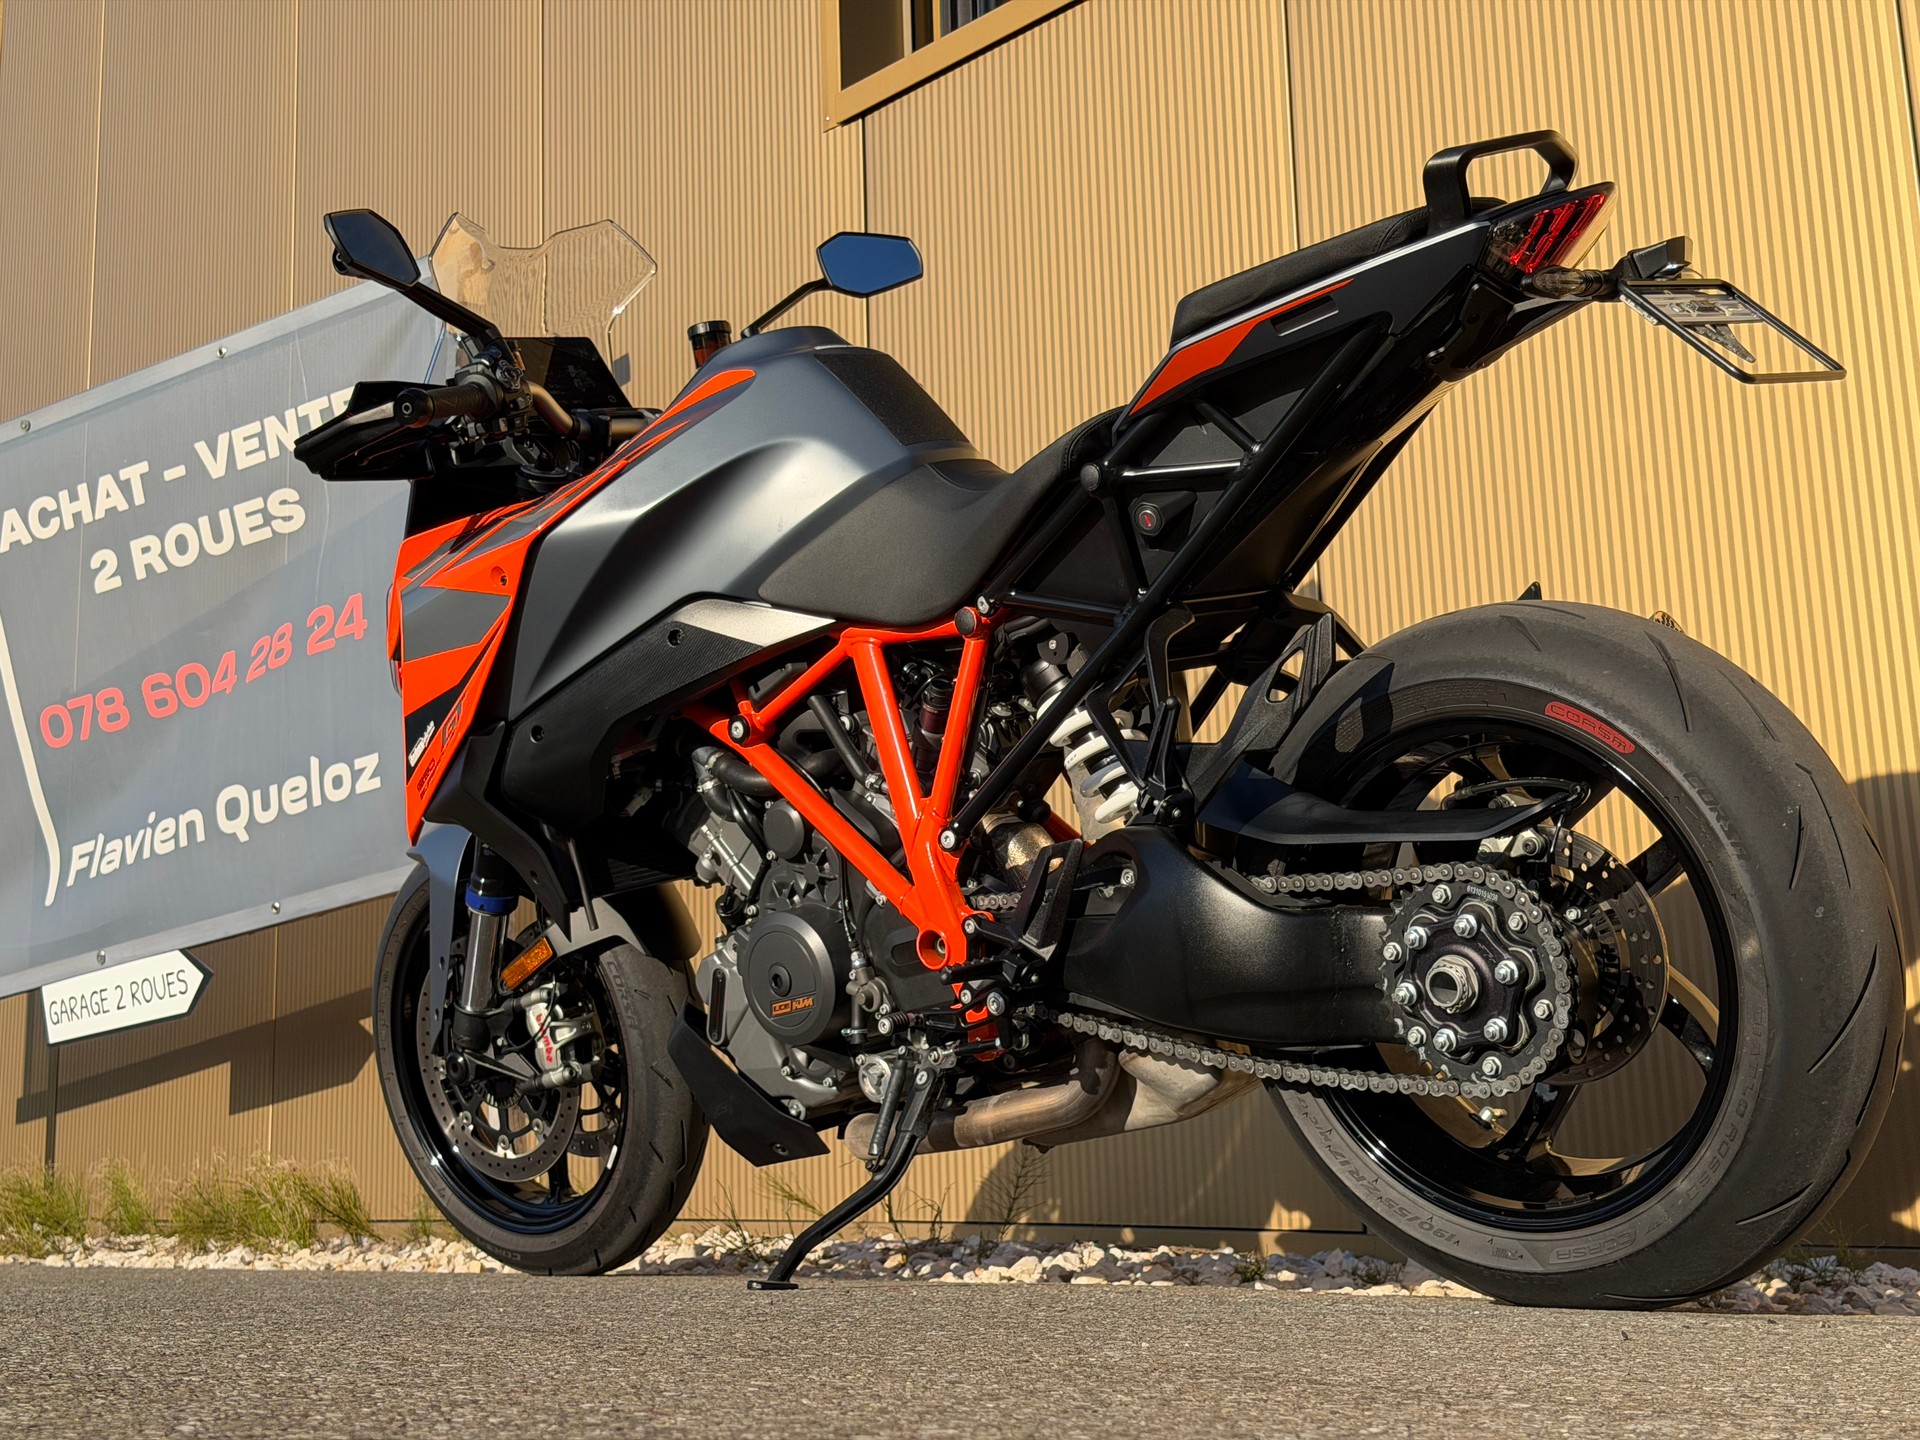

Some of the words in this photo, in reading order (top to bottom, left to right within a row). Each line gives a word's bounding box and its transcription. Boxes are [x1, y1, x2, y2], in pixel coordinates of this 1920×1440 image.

[0, 460, 149, 552] ACHAT
[90, 548, 122, 594] 2
[129, 487, 306, 581] ROUES
[40, 687, 130, 748] 078
[141, 650, 238, 719] 604
[245, 622, 293, 684] 28
[306, 592, 368, 656] 24
[1549, 704, 1628, 752] CORSA
[66, 808, 206, 888] Flavien
[216, 752, 382, 843] Queloz
[48, 986, 109, 1026] GARAGE
[115, 984, 127, 1011] 2
[131, 969, 189, 1005] ROUES
[792, 996, 813, 1010] KTM
